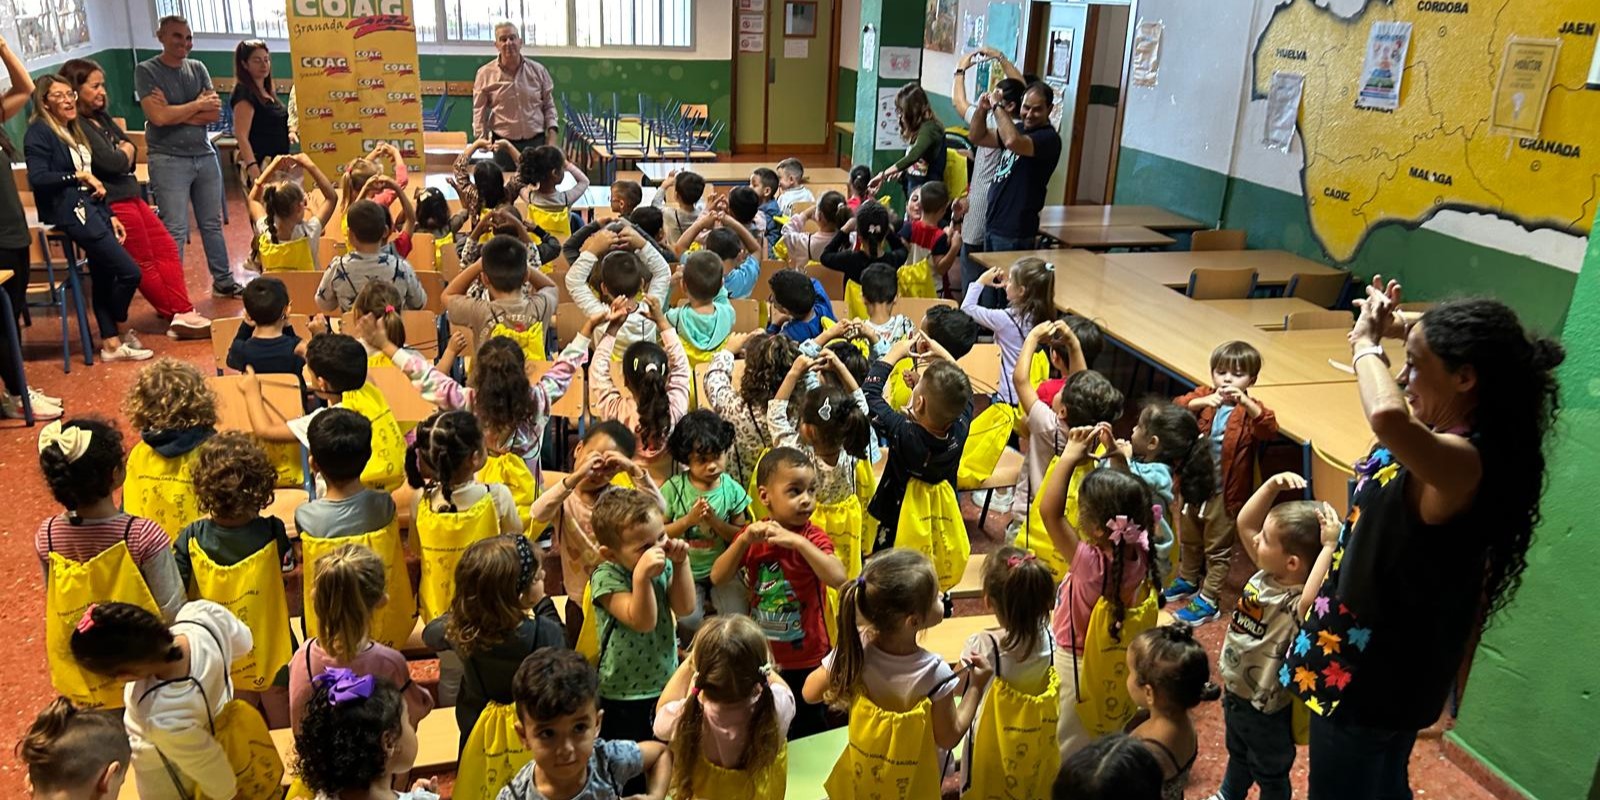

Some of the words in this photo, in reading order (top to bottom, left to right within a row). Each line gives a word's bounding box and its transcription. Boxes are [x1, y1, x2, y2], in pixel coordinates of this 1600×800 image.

[296, 0, 402, 17] COAG
[1417, 0, 1468, 14] CORDOBA
[294, 19, 344, 38] Granada
[1558, 22, 1595, 36] JAEN
[355, 50, 382, 58] COAG
[1275, 48, 1307, 60] HUELVA
[302, 57, 347, 68] COAG
[384, 63, 413, 71] COAG
[329, 91, 358, 99] COAG
[387, 92, 416, 100] COAG
[306, 108, 333, 116] COAG
[333, 122, 361, 130] COAG
[310, 142, 336, 150] COAG
[1519, 137, 1580, 158] GRANADA
[1409, 167, 1452, 186] MALAGA
[1323, 187, 1350, 201] CADIZ
[1237, 612, 1265, 635] WORLD
